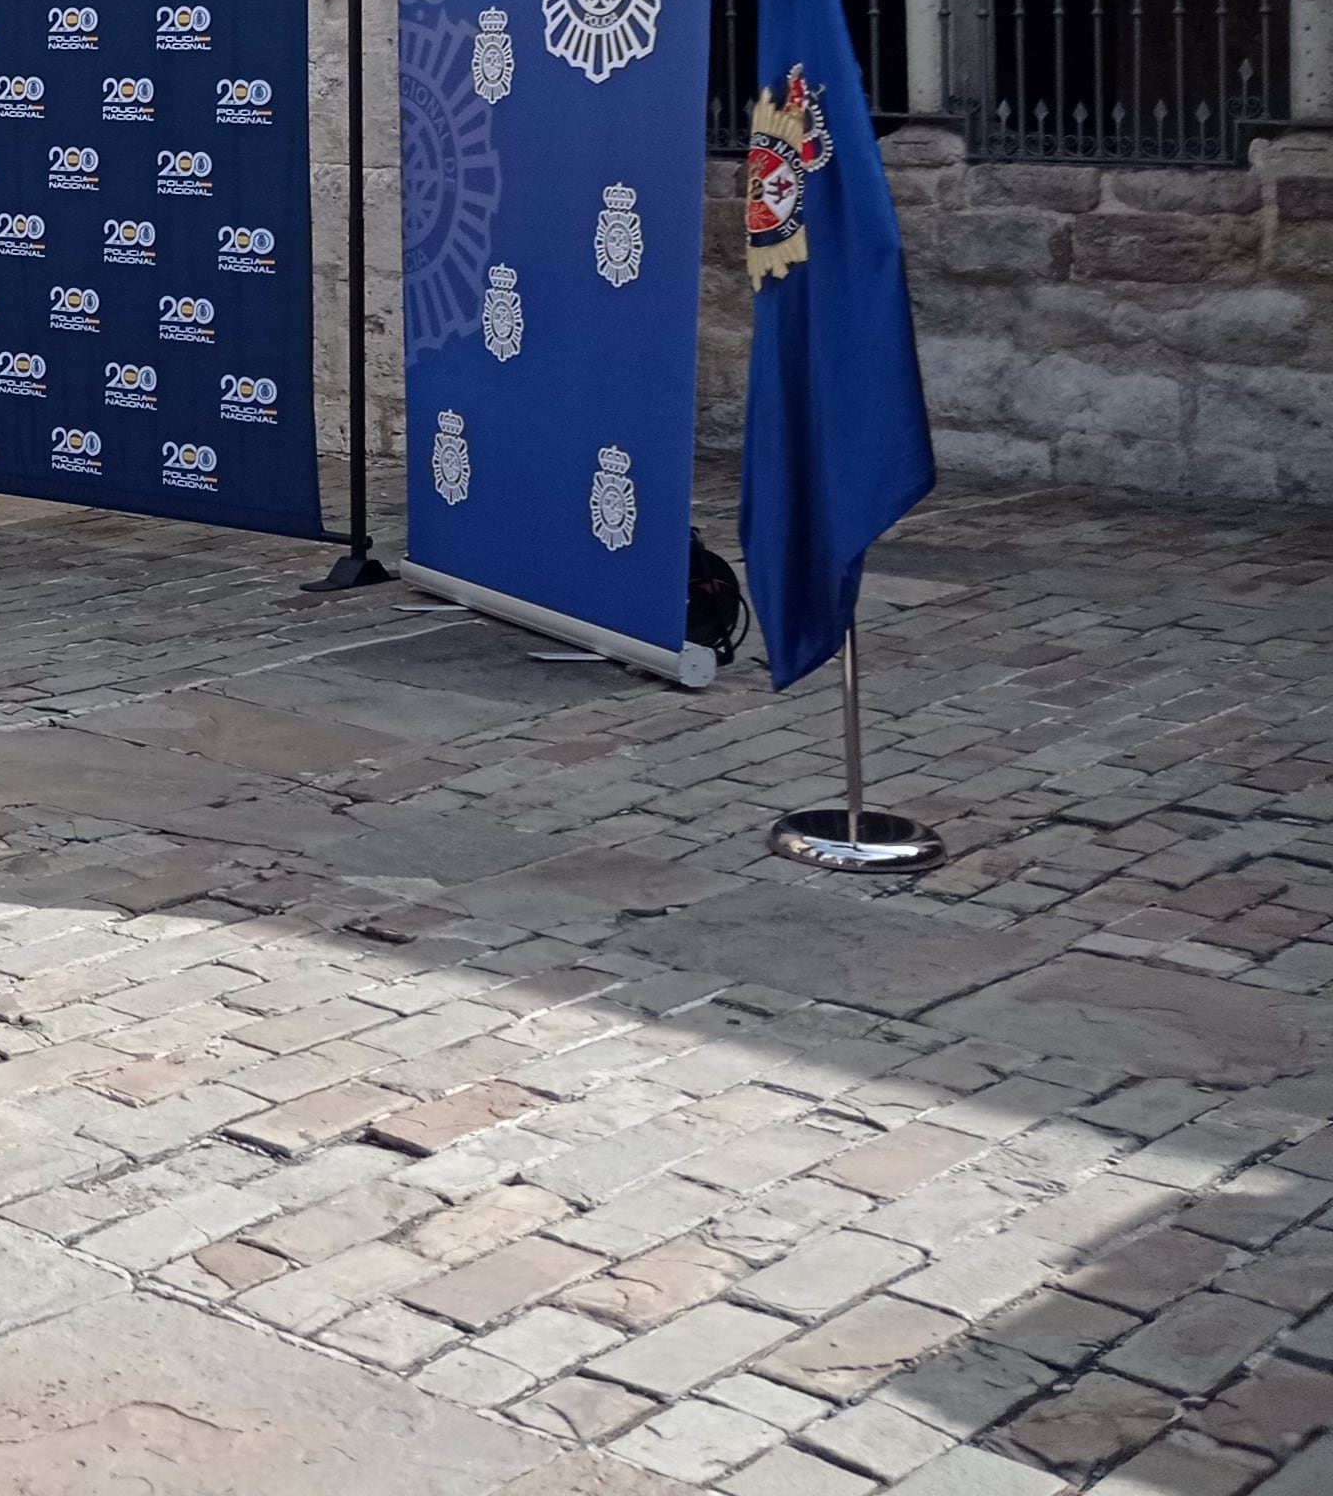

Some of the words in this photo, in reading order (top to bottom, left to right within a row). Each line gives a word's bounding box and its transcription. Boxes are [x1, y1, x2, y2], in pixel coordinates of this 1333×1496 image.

[49, 7, 98, 32] 200
[157, 6, 210, 32] 200
[103, 78, 153, 103] 200
[217, 79, 271, 105] 200
[49, 147, 98, 172] 200
[158, 151, 212, 177] 200
[104, 220, 155, 246] 200
[218, 226, 274, 254] 200
[778, 218, 799, 237] DE
[50, 286, 99, 314] 200
[160, 296, 214, 324] 200
[106, 363, 156, 391] 200
[221, 375, 277, 404] 200
[52, 427, 101, 456] 200
[163, 442, 216, 471] 200
